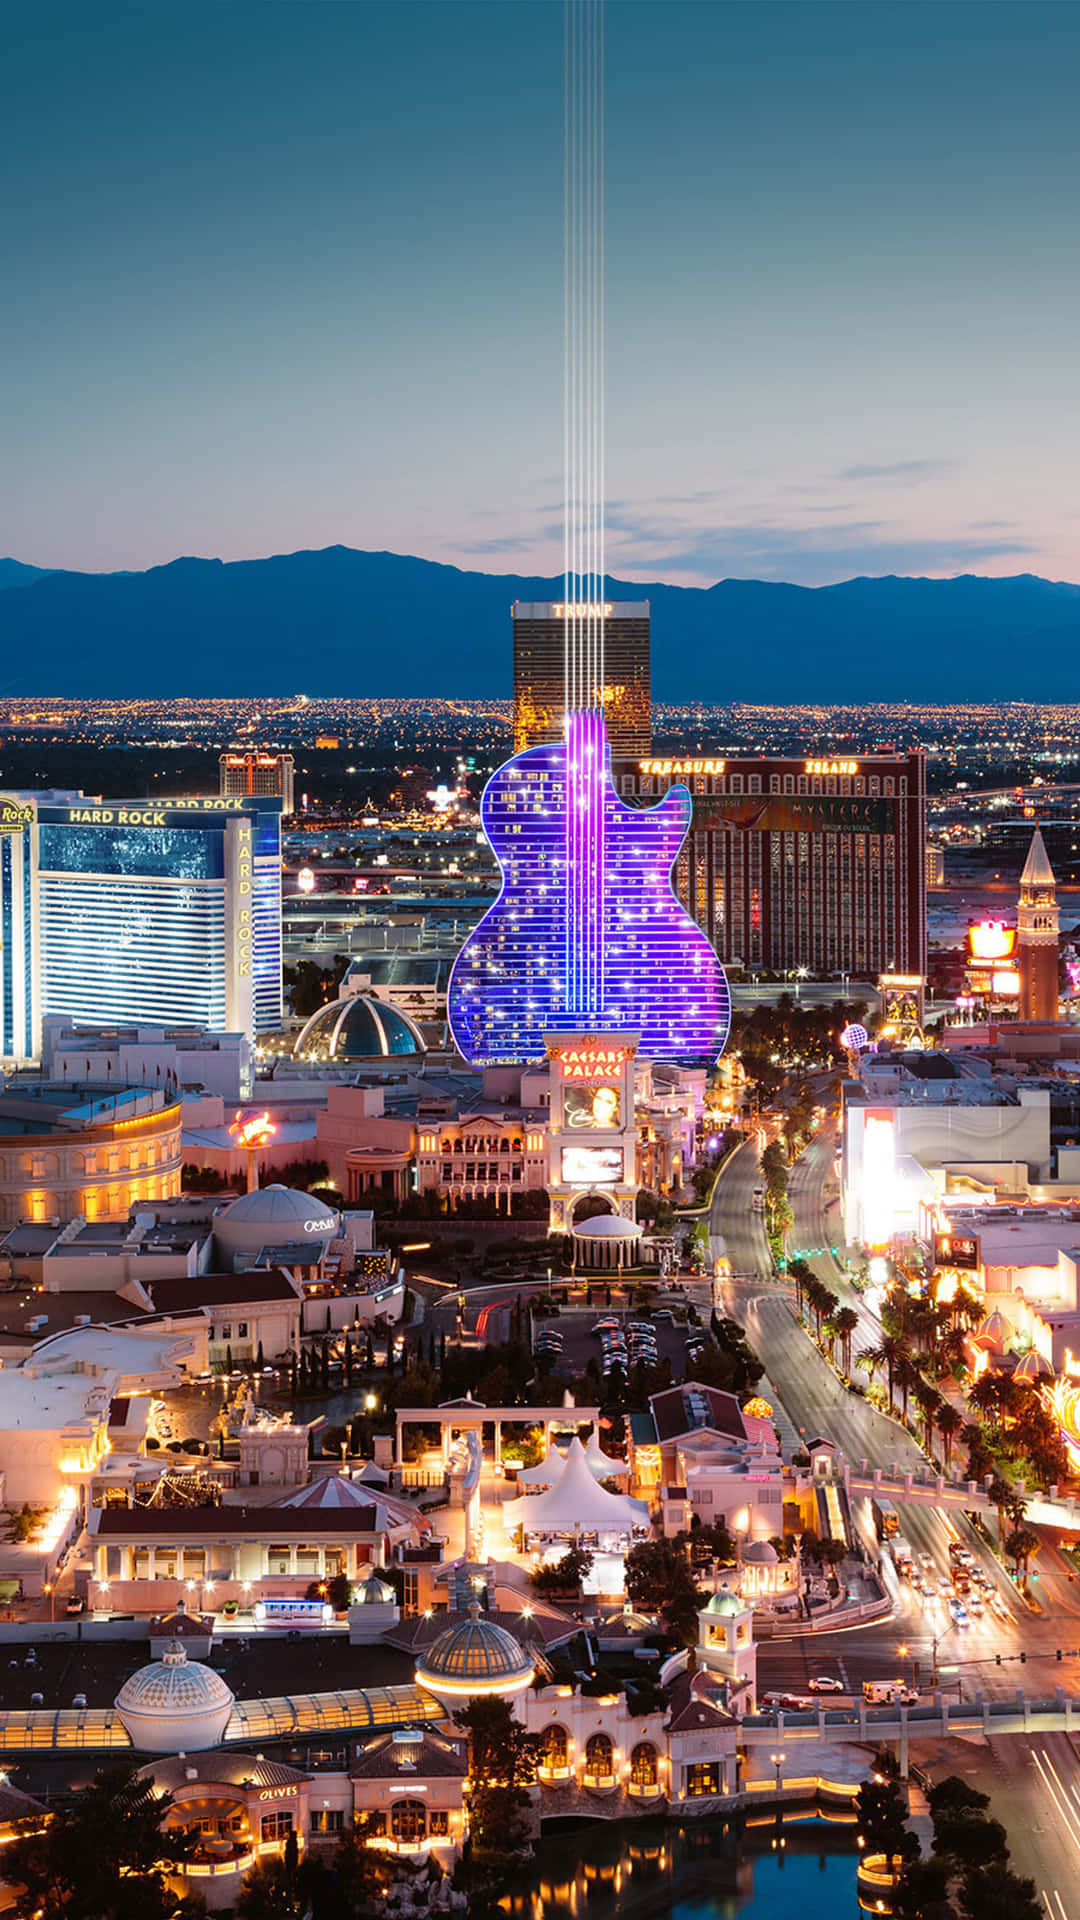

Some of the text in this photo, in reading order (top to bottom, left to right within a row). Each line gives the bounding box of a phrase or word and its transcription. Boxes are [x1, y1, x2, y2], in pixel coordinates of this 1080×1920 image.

[552, 603, 614, 617] TRUMP
[640, 760, 858, 775] TREASURE ISLAND
[2, 806, 33, 823] Rock
[69, 810, 167, 825] HARD ROCK
[239, 829, 251, 976] HARD ROCK
[560, 1051, 625, 1063] CAESARS
[563, 1065, 622, 1077] PALACE
[259, 1786, 298, 1801] OLIVES
